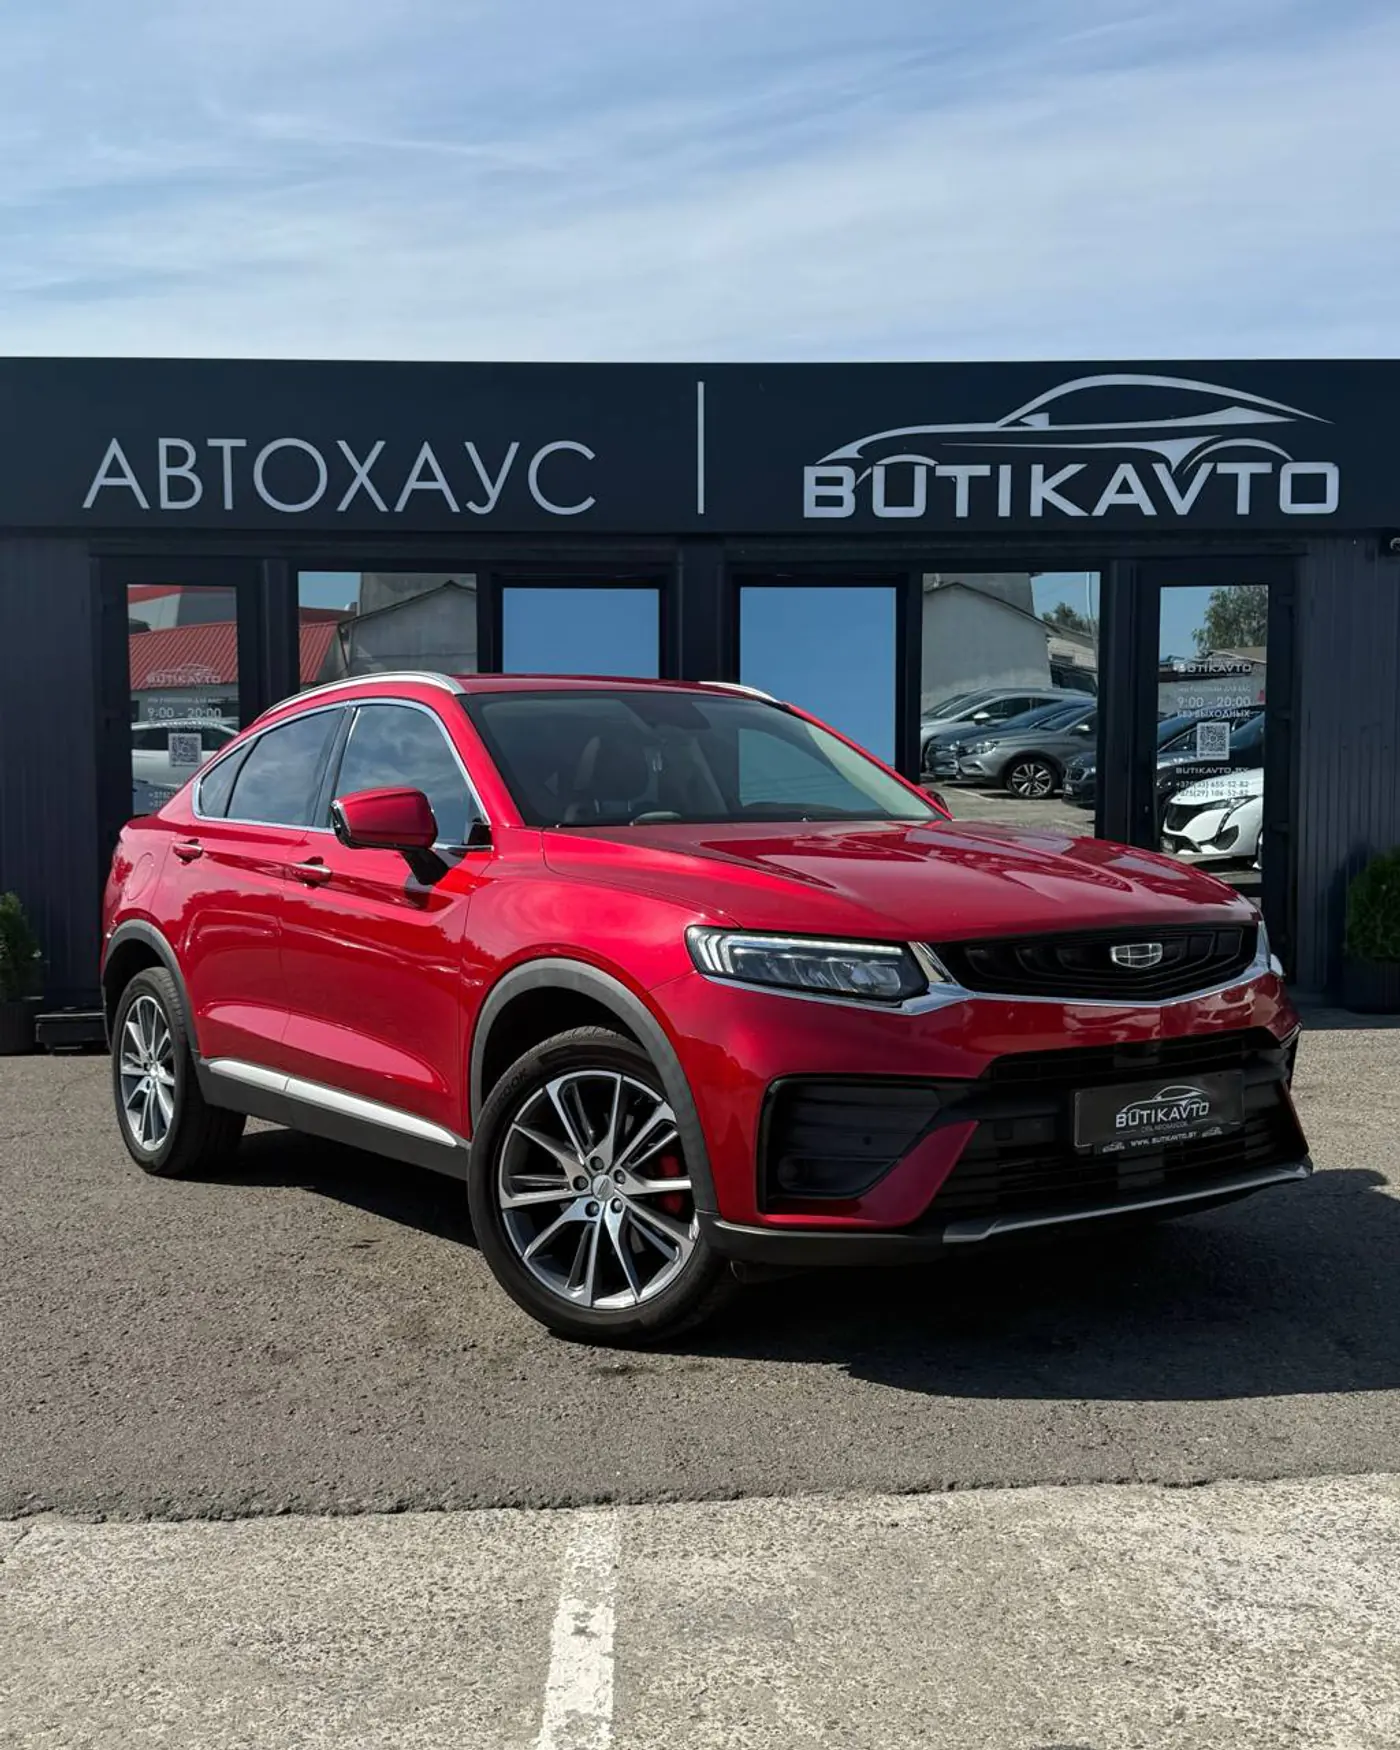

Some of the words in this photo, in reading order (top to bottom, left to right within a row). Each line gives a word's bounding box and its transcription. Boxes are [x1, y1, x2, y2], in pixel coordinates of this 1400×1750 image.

[82, 437, 596, 515] АВТОХАУС
[803, 461, 1340, 519] BUTIKAVTO
[147, 707, 175, 718] 9:00
[187, 707, 222, 718] 20:00
[1178, 696, 1204, 708] 9:00
[1216, 696, 1252, 708] 20:00
[1115, 1102, 1209, 1128] BUTIKAVTO
